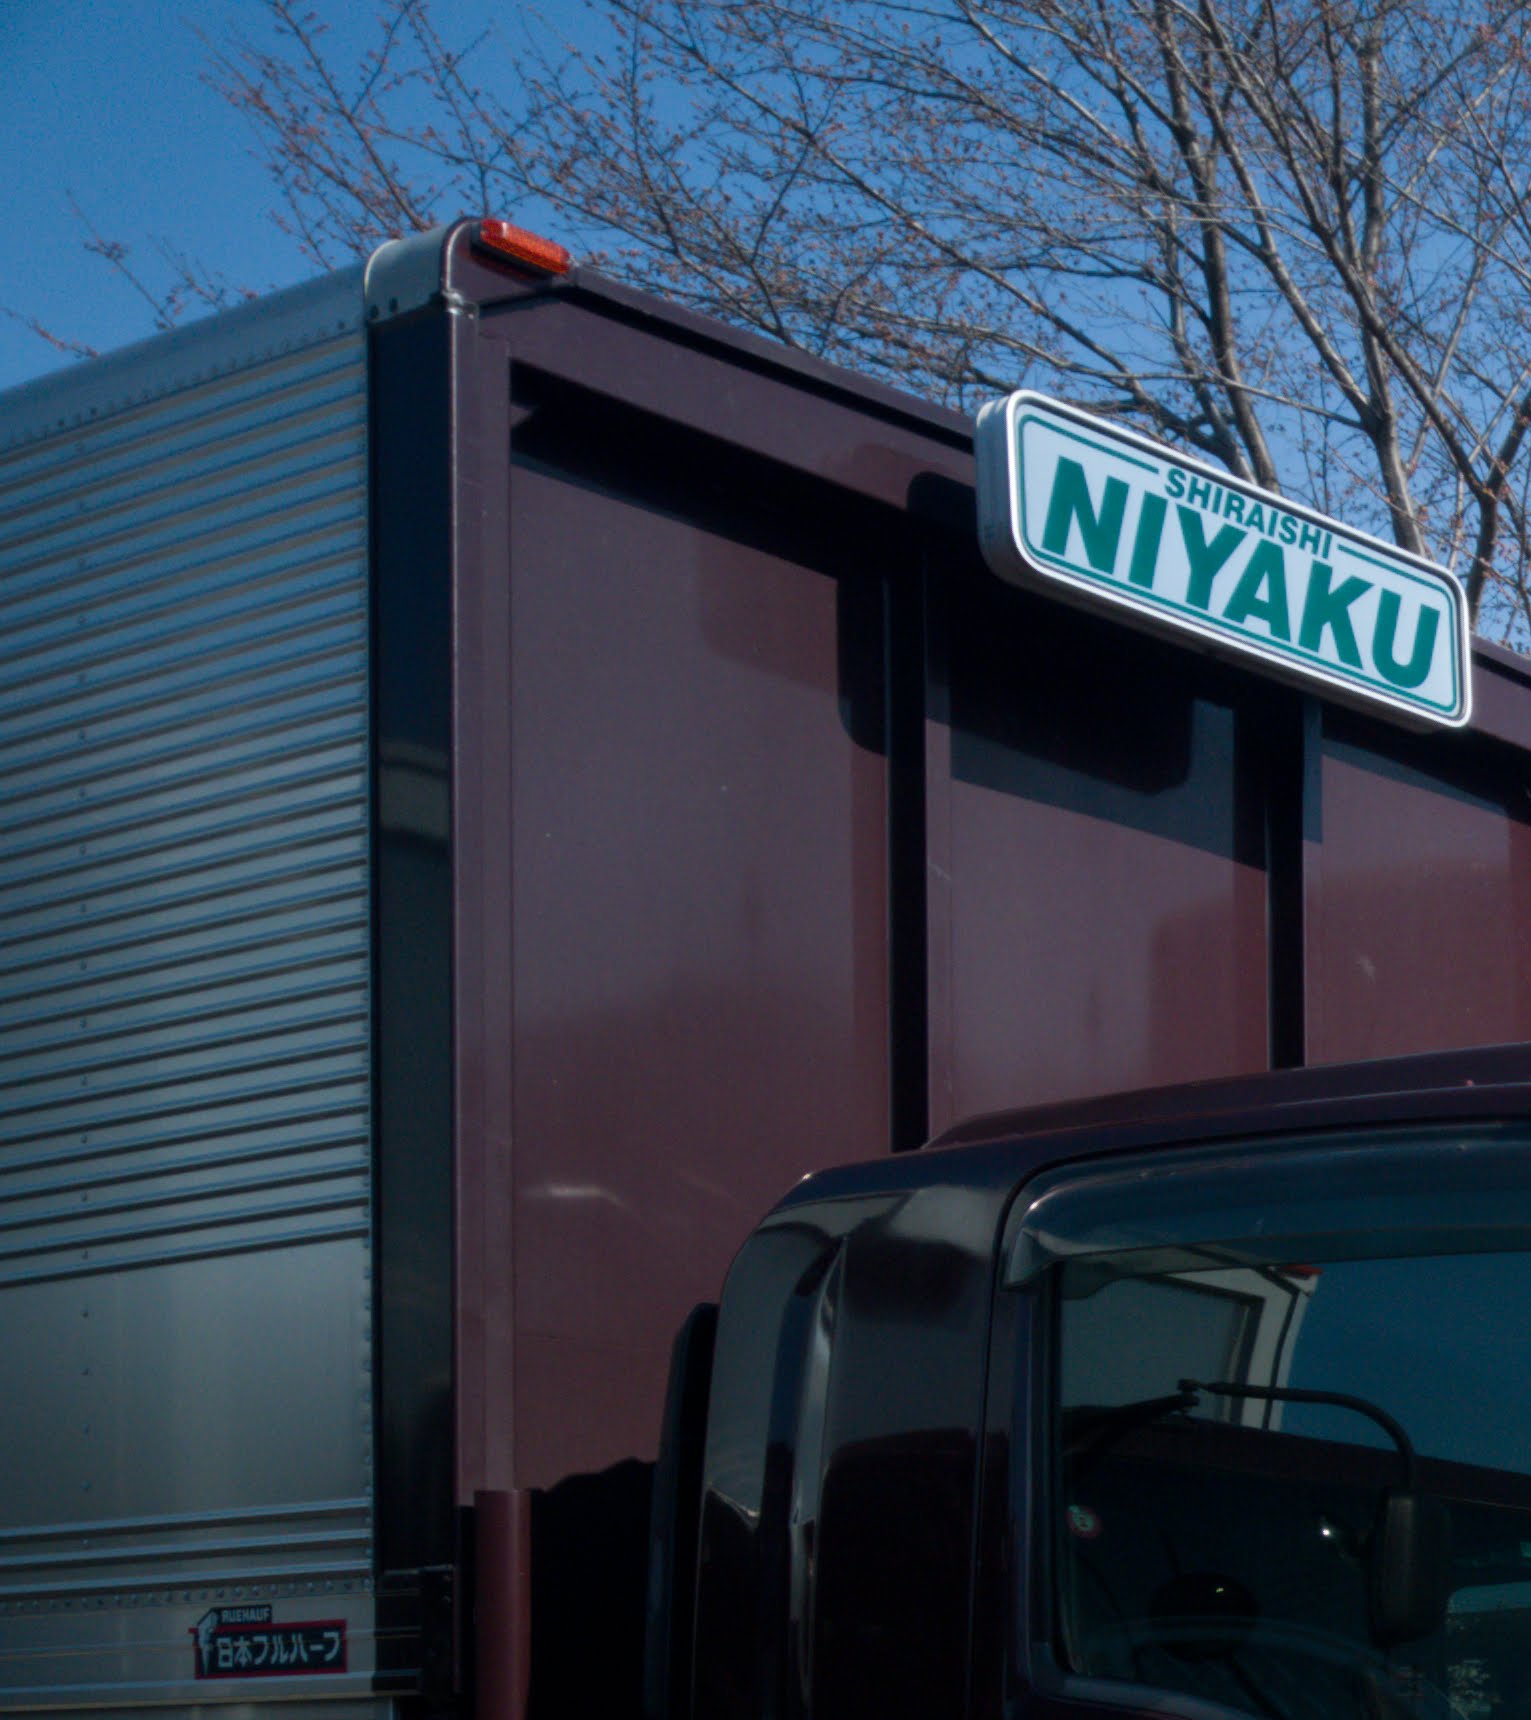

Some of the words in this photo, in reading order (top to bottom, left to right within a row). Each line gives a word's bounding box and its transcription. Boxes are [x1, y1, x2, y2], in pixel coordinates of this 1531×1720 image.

[1164, 468, 1332, 559] SHIRAISHI
[1041, 456, 1440, 689] NIYAKU
[216, 1631, 341, 1668] 日本フルハーフ
